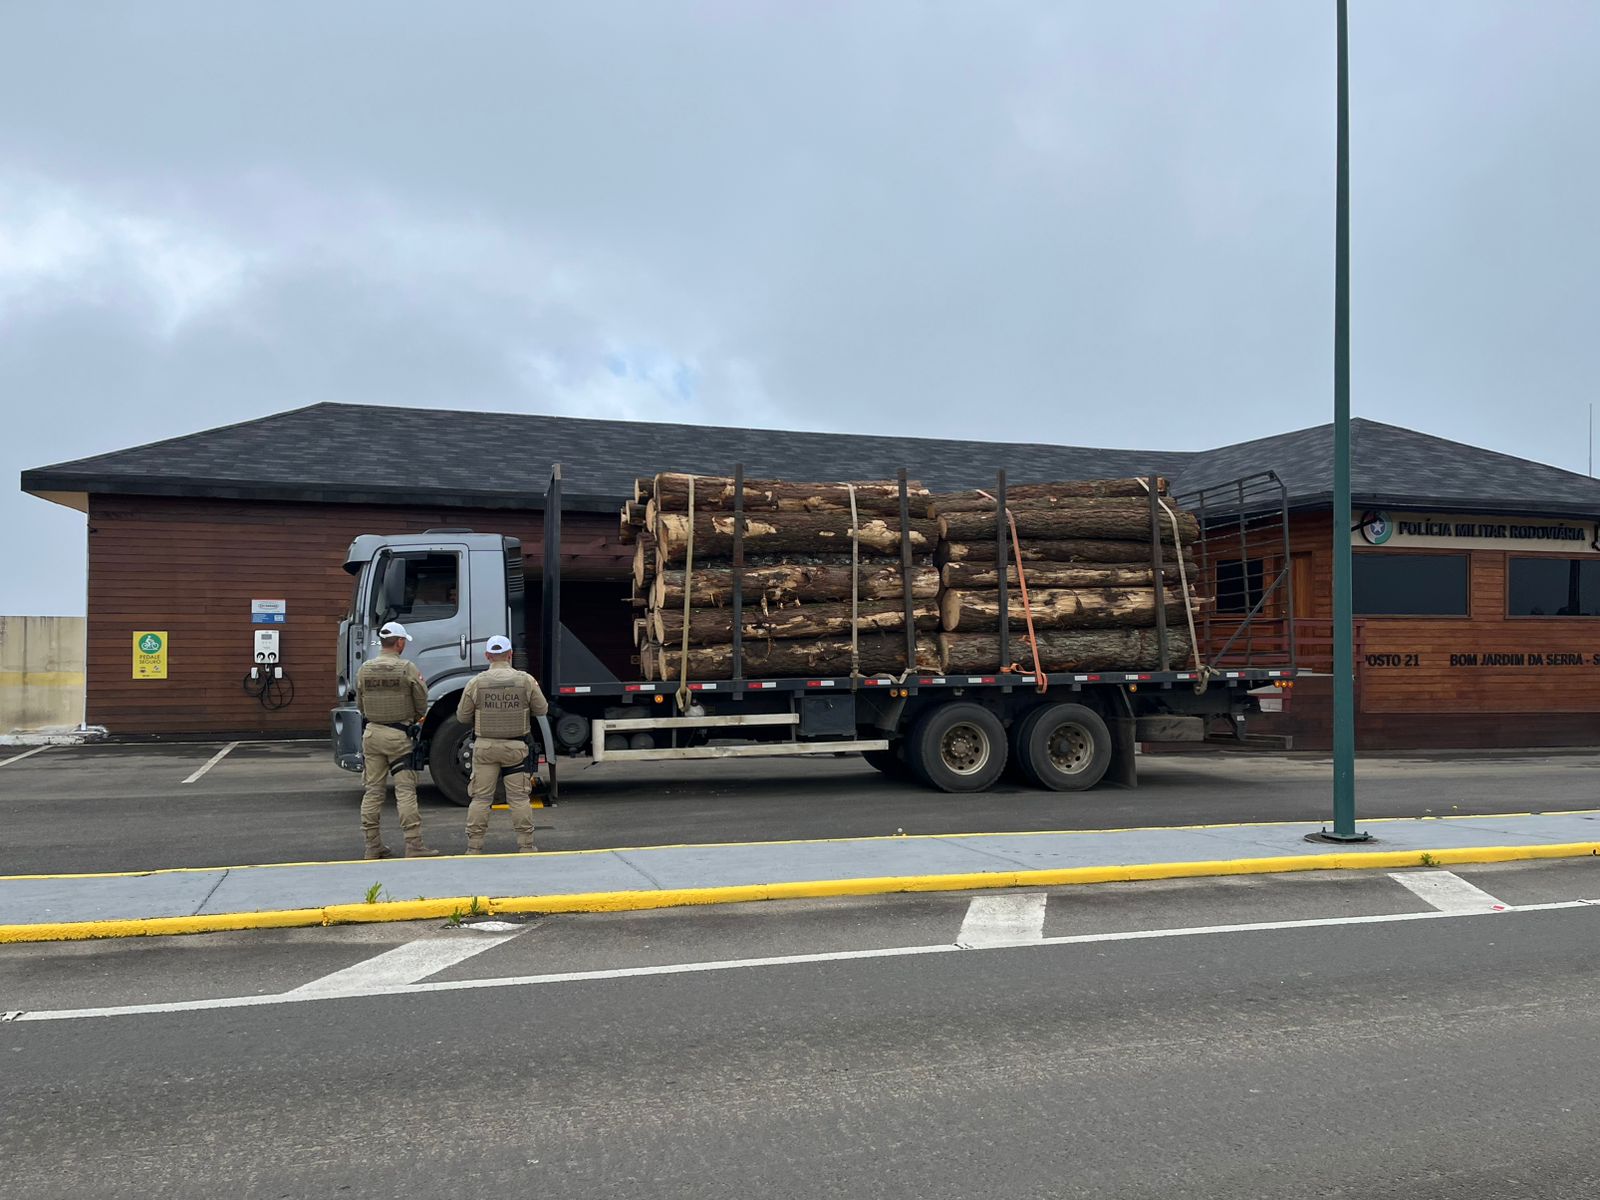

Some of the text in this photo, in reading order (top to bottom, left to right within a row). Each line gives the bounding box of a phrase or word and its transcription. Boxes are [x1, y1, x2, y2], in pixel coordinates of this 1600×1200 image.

[1399, 518, 1586, 541] POLÍCIA MILITAR RODOVIÁRIA
[1404, 653, 1420, 666] 21
[1450, 654, 1477, 666] BOM
[1480, 653, 1524, 666] JARDIM
[1528, 653, 1544, 666] DA
[1546, 653, 1583, 666] SERRA
[485, 692, 519, 701] POLÍCIA
